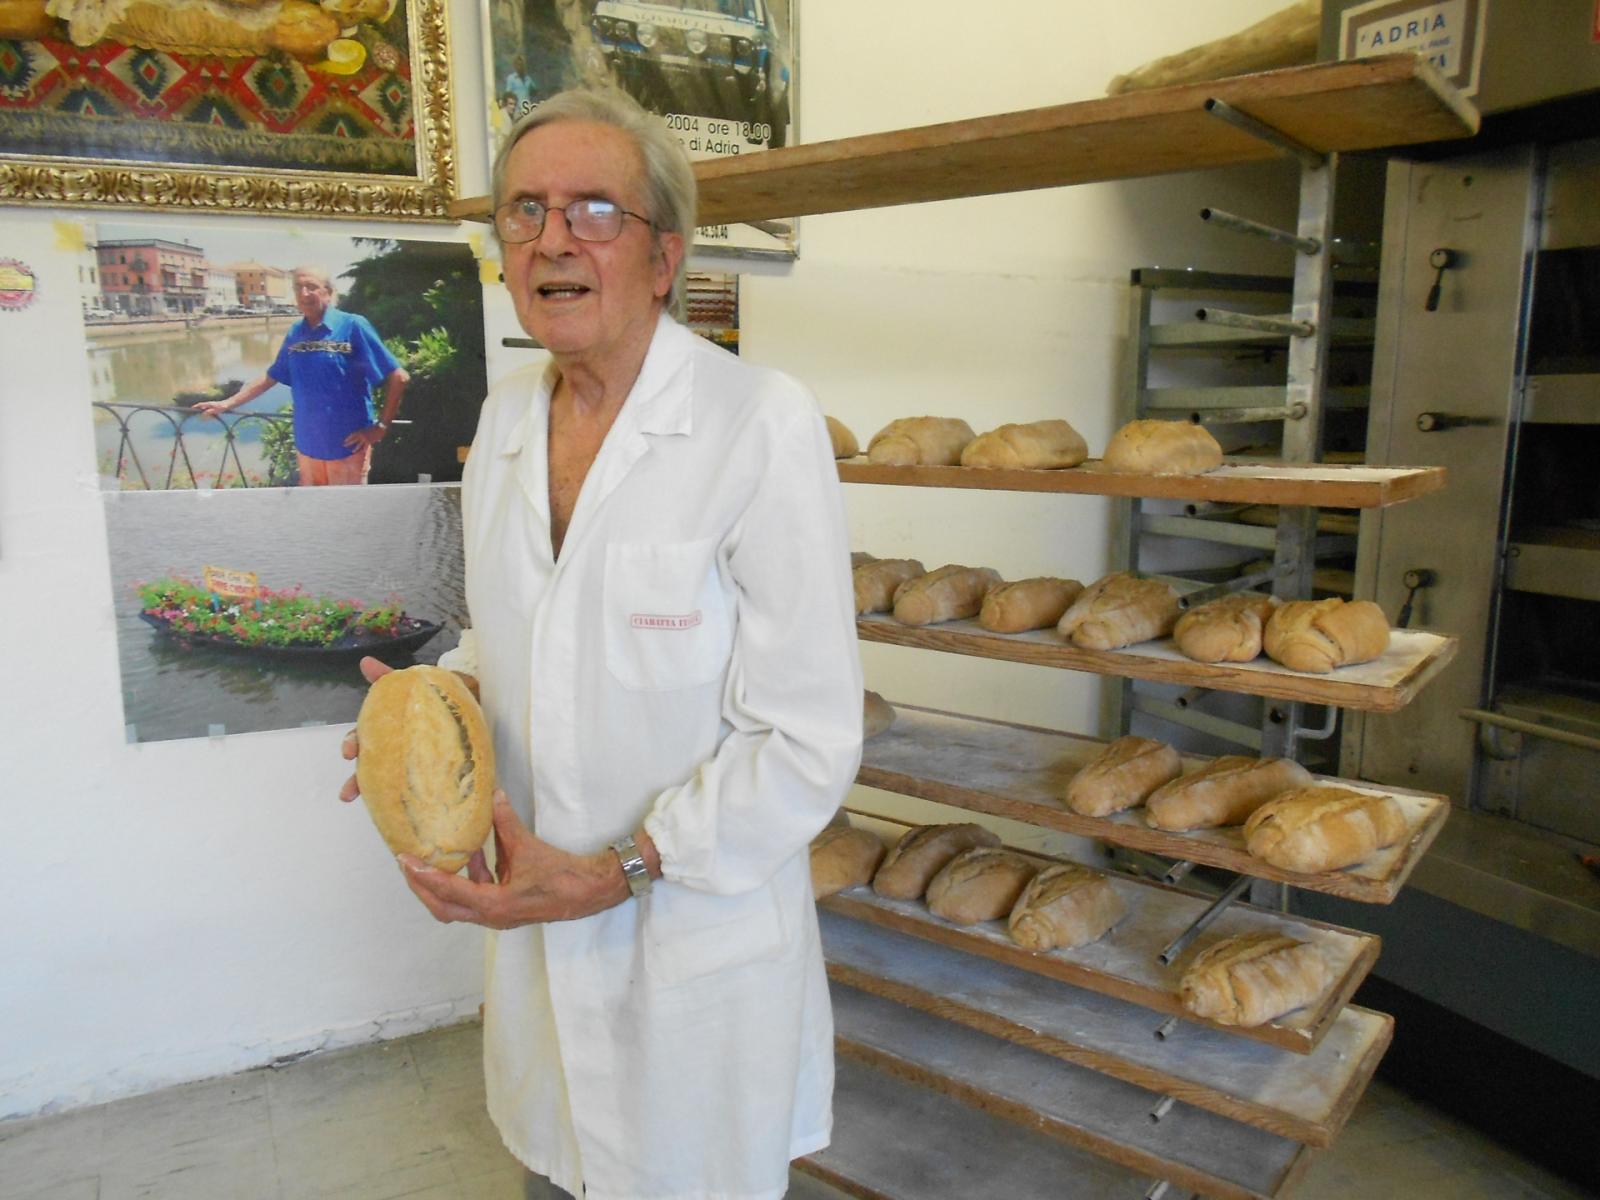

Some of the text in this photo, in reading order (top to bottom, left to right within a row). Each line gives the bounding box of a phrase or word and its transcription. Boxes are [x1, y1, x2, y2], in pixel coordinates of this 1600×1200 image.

[666, 114, 699, 132] 2004
[707, 122, 729, 136] ore
[689, 138, 702, 152] di
[705, 139, 740, 155] Adria
